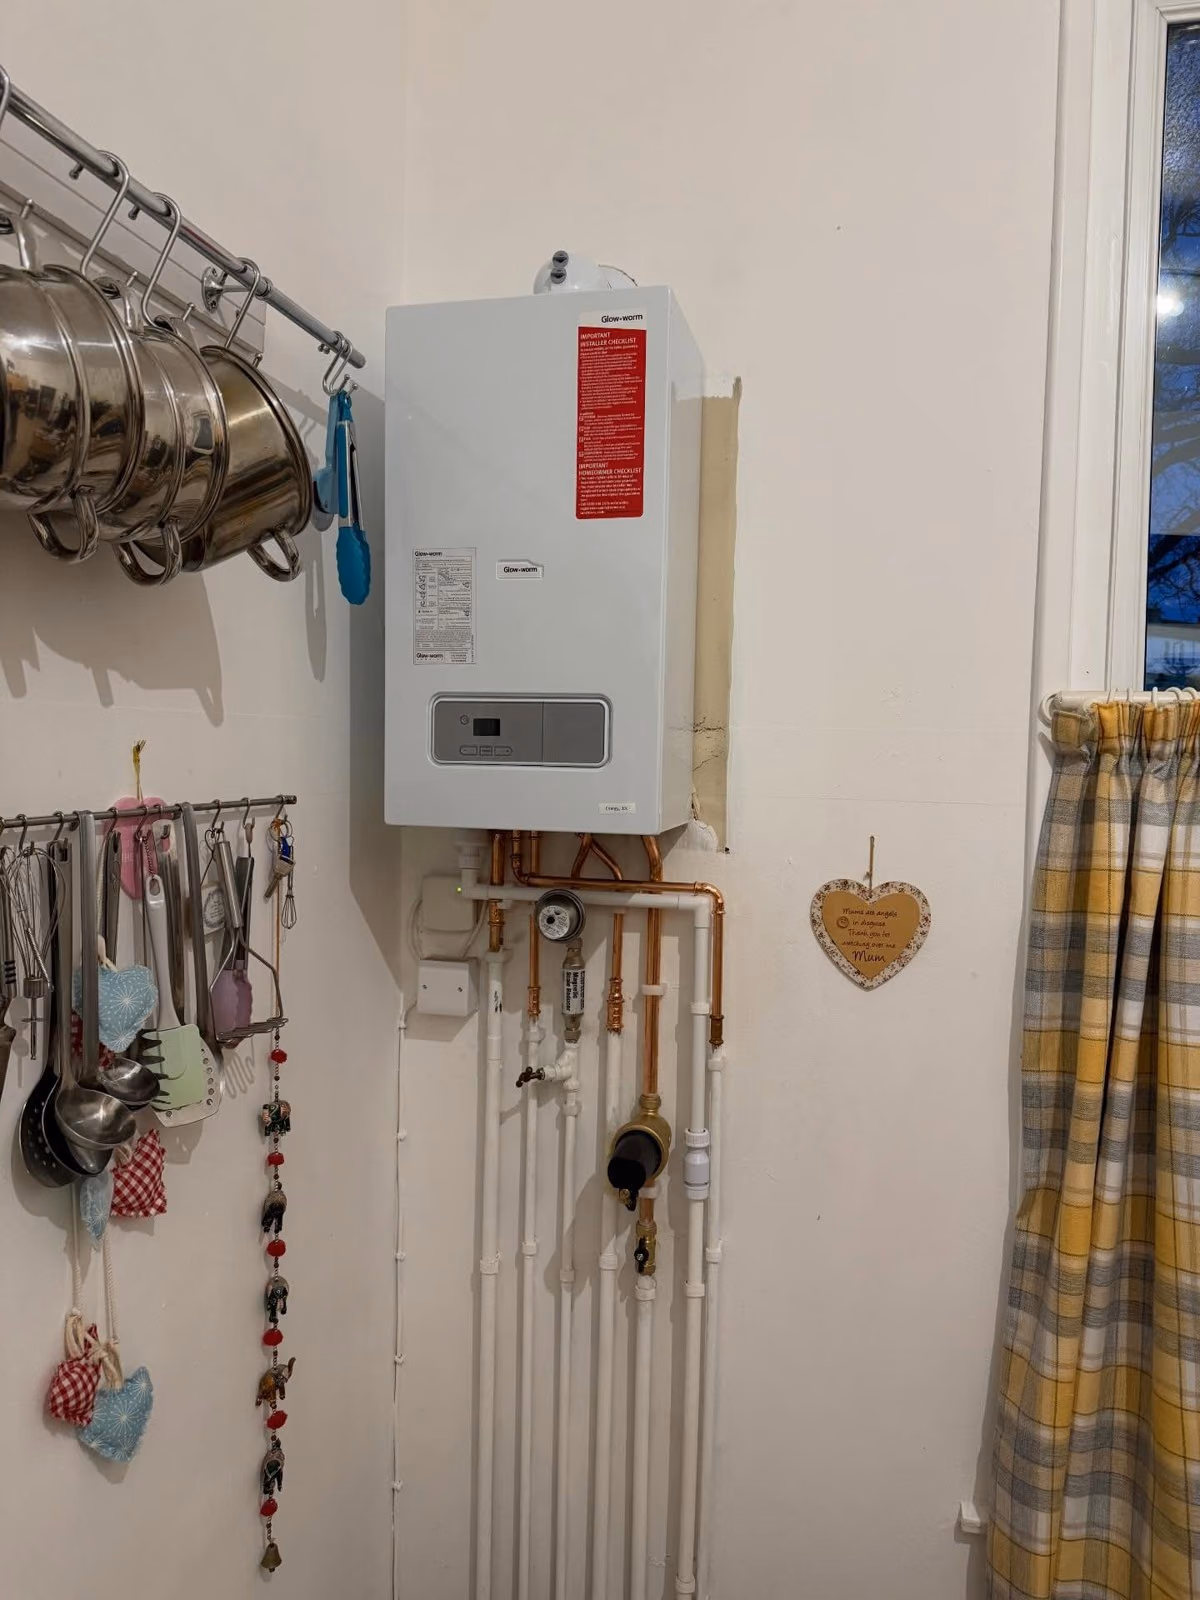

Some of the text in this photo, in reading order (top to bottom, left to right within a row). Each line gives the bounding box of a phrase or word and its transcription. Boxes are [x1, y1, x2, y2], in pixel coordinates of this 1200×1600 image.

[580, 332, 611, 340] IMPORTANT
[580, 337, 636, 348] INSTALLER CHECKLIST
[578, 468, 613, 476] HOMEOWNER
[843, 908, 864, 916] Mums
[876, 909, 897, 918] angels
[852, 950, 885, 962] Mum
